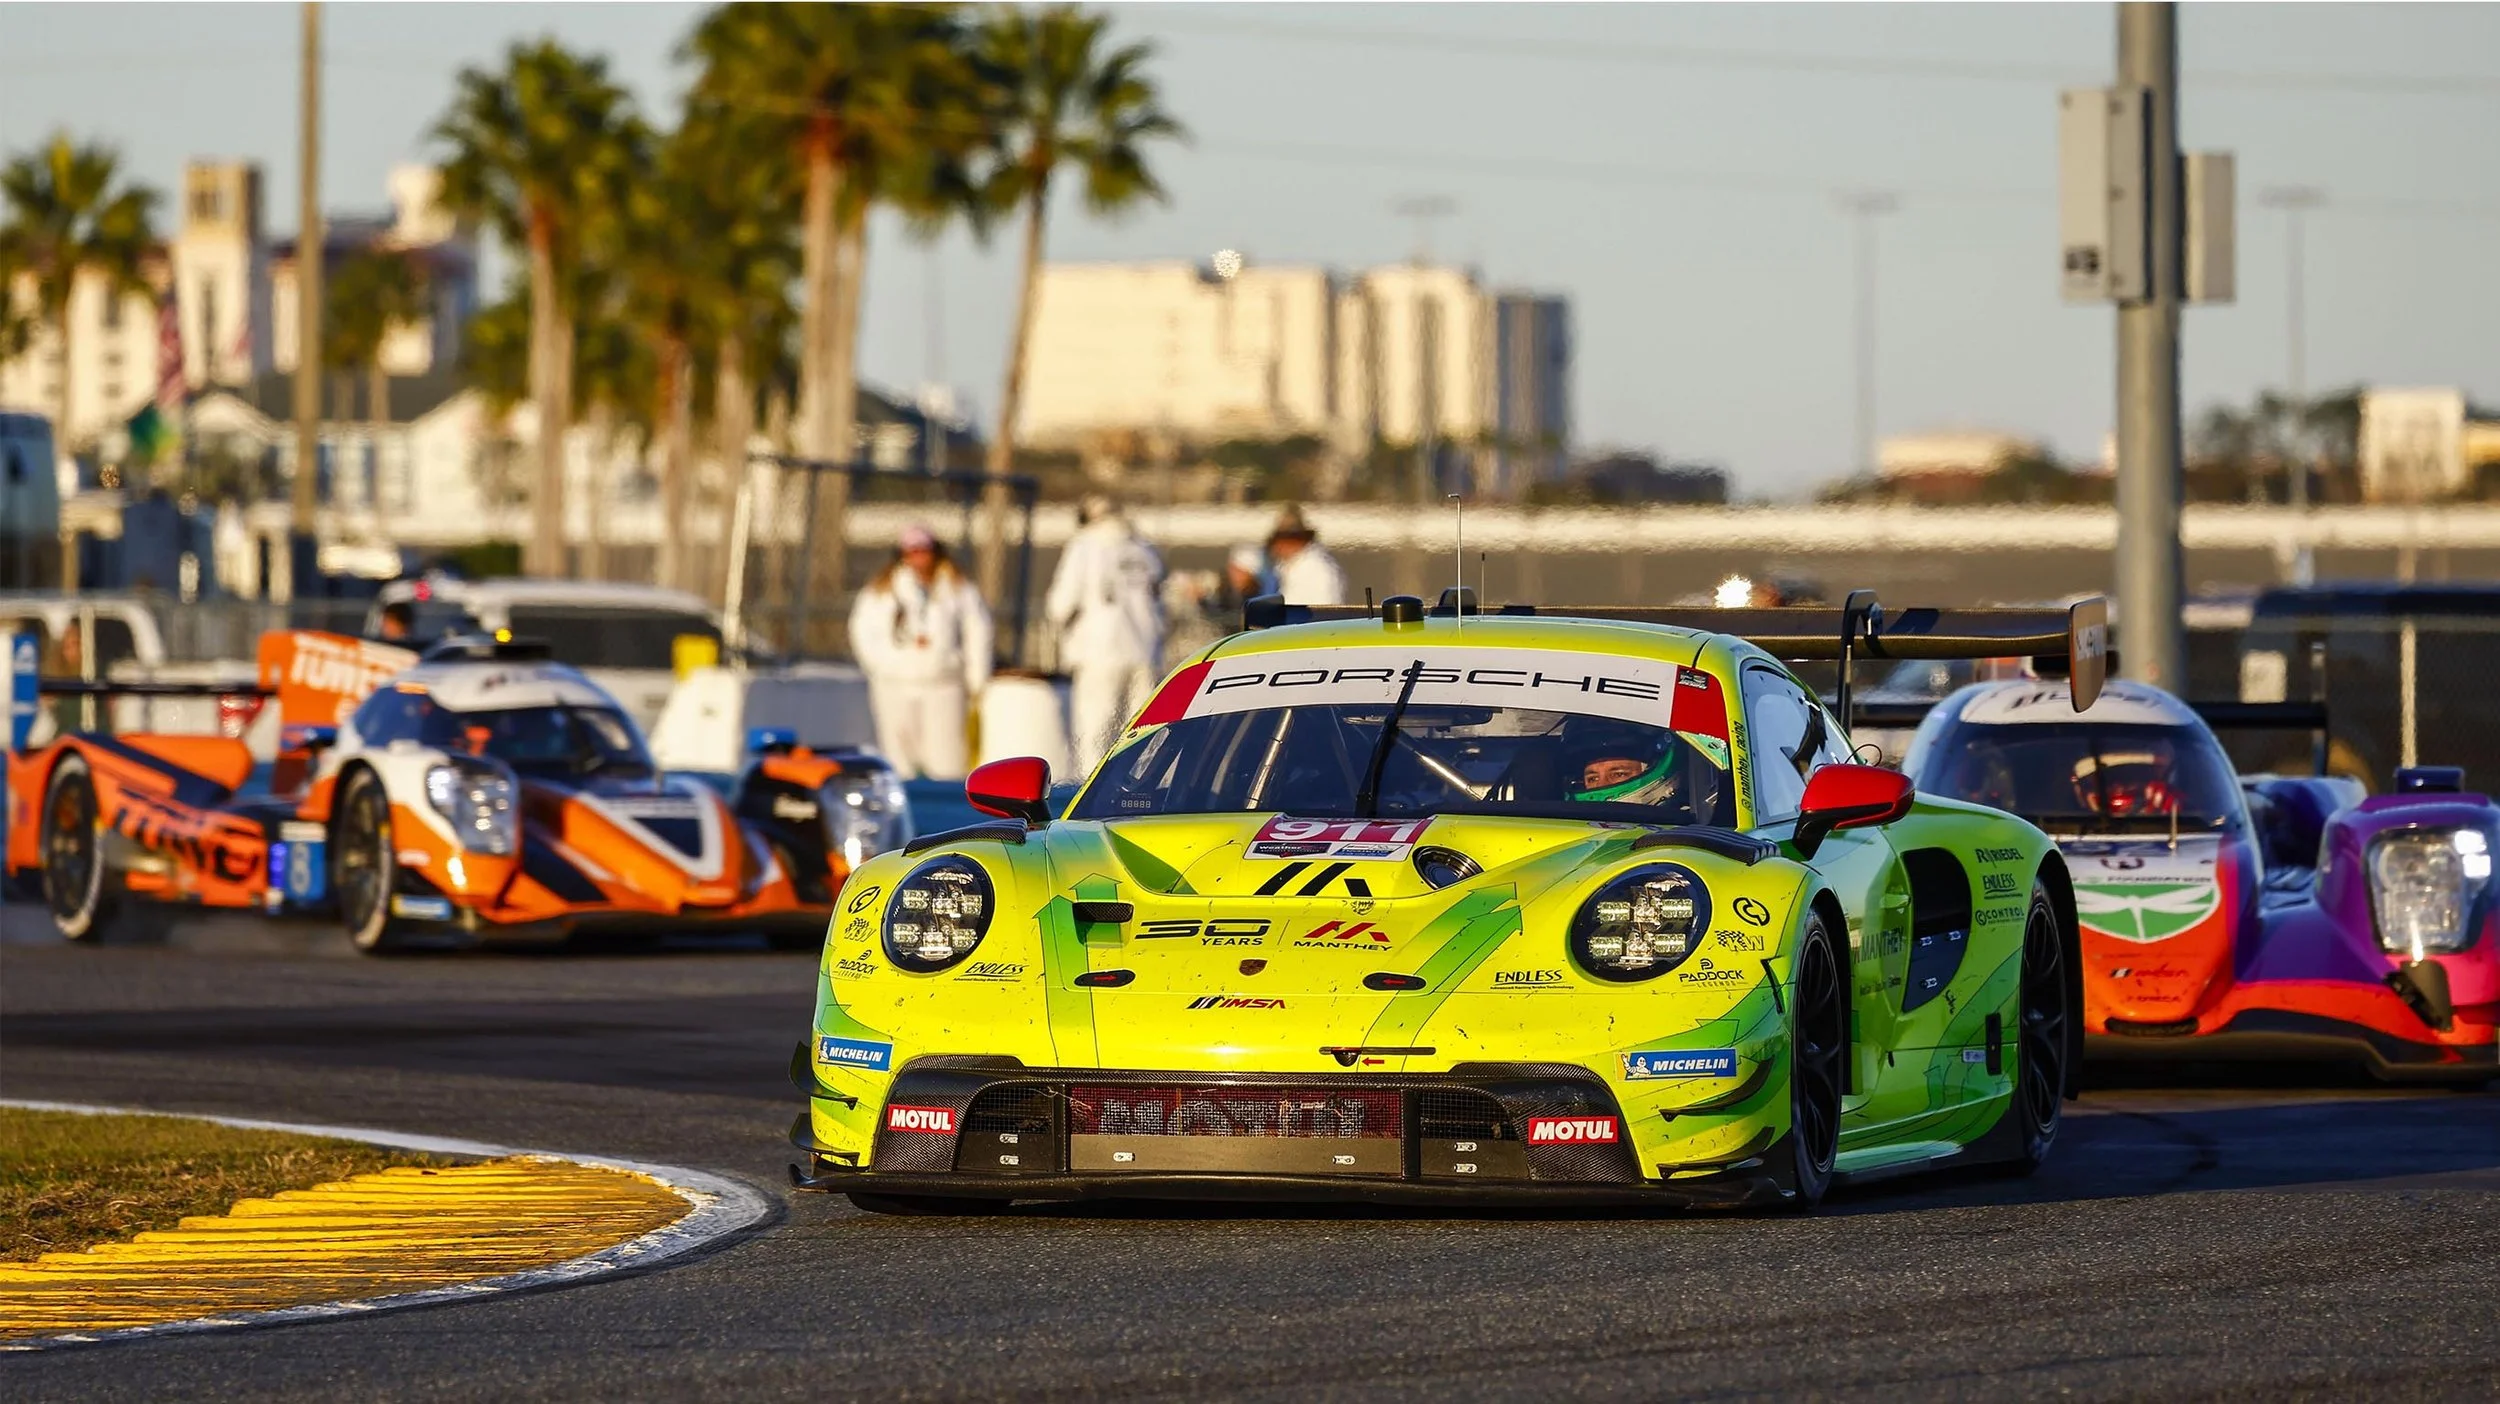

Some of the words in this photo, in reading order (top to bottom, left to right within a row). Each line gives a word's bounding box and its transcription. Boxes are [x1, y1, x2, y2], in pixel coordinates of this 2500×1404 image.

[1205, 668, 1662, 701] PORSCHE
[1269, 819, 1425, 842] 911
[1201, 937, 1263, 946] YEARS
[1293, 940, 1393, 952] MANTHEY
[836, 958, 879, 976] PADDOCK
[964, 961, 1028, 975] ENDLESS
[1494, 968, 1563, 983] ENDLESS
[1678, 970, 1745, 983] PADDOCK
[1218, 998, 1286, 1010] IMSA
[828, 1046, 883, 1063] MICHELIN
[1652, 1058, 1729, 1072] MICHELIN
[890, 1108, 952, 1131] MOTUL
[1532, 1120, 1614, 1141] MOTUL
